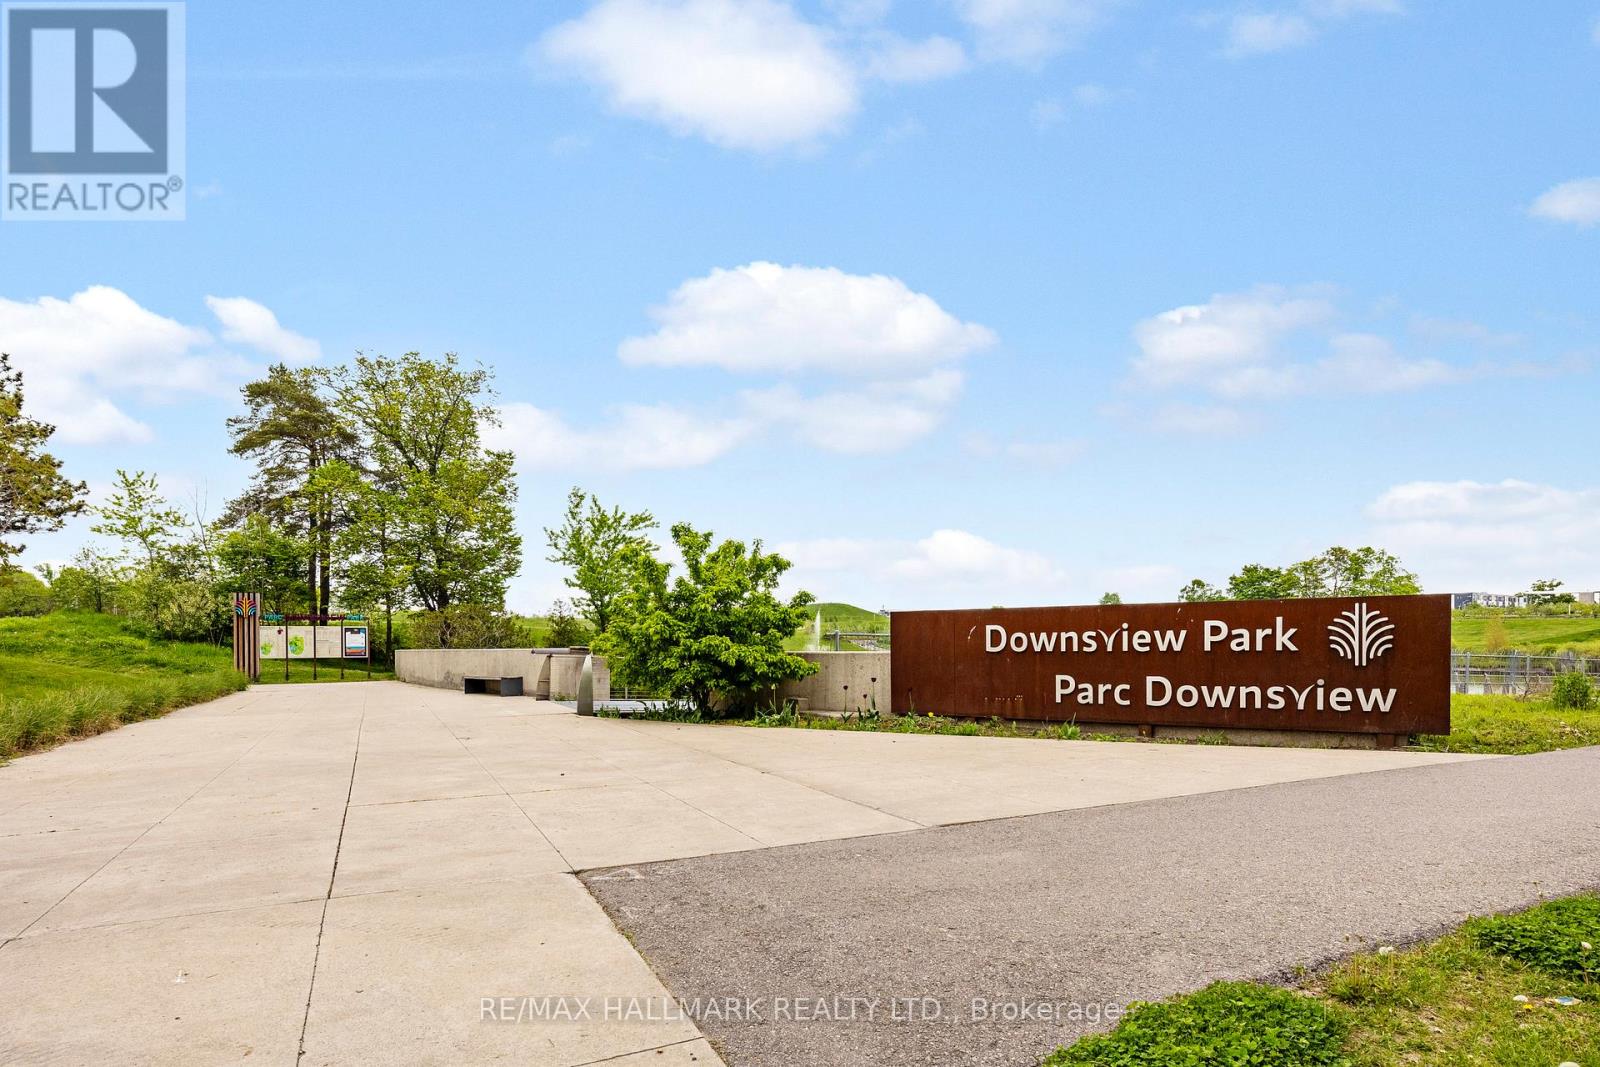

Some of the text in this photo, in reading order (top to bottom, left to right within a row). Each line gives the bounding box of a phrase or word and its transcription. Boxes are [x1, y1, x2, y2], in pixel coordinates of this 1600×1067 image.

[985, 616, 1299, 653] Downsview Park
[1055, 674, 1397, 712] Parc Downsview
